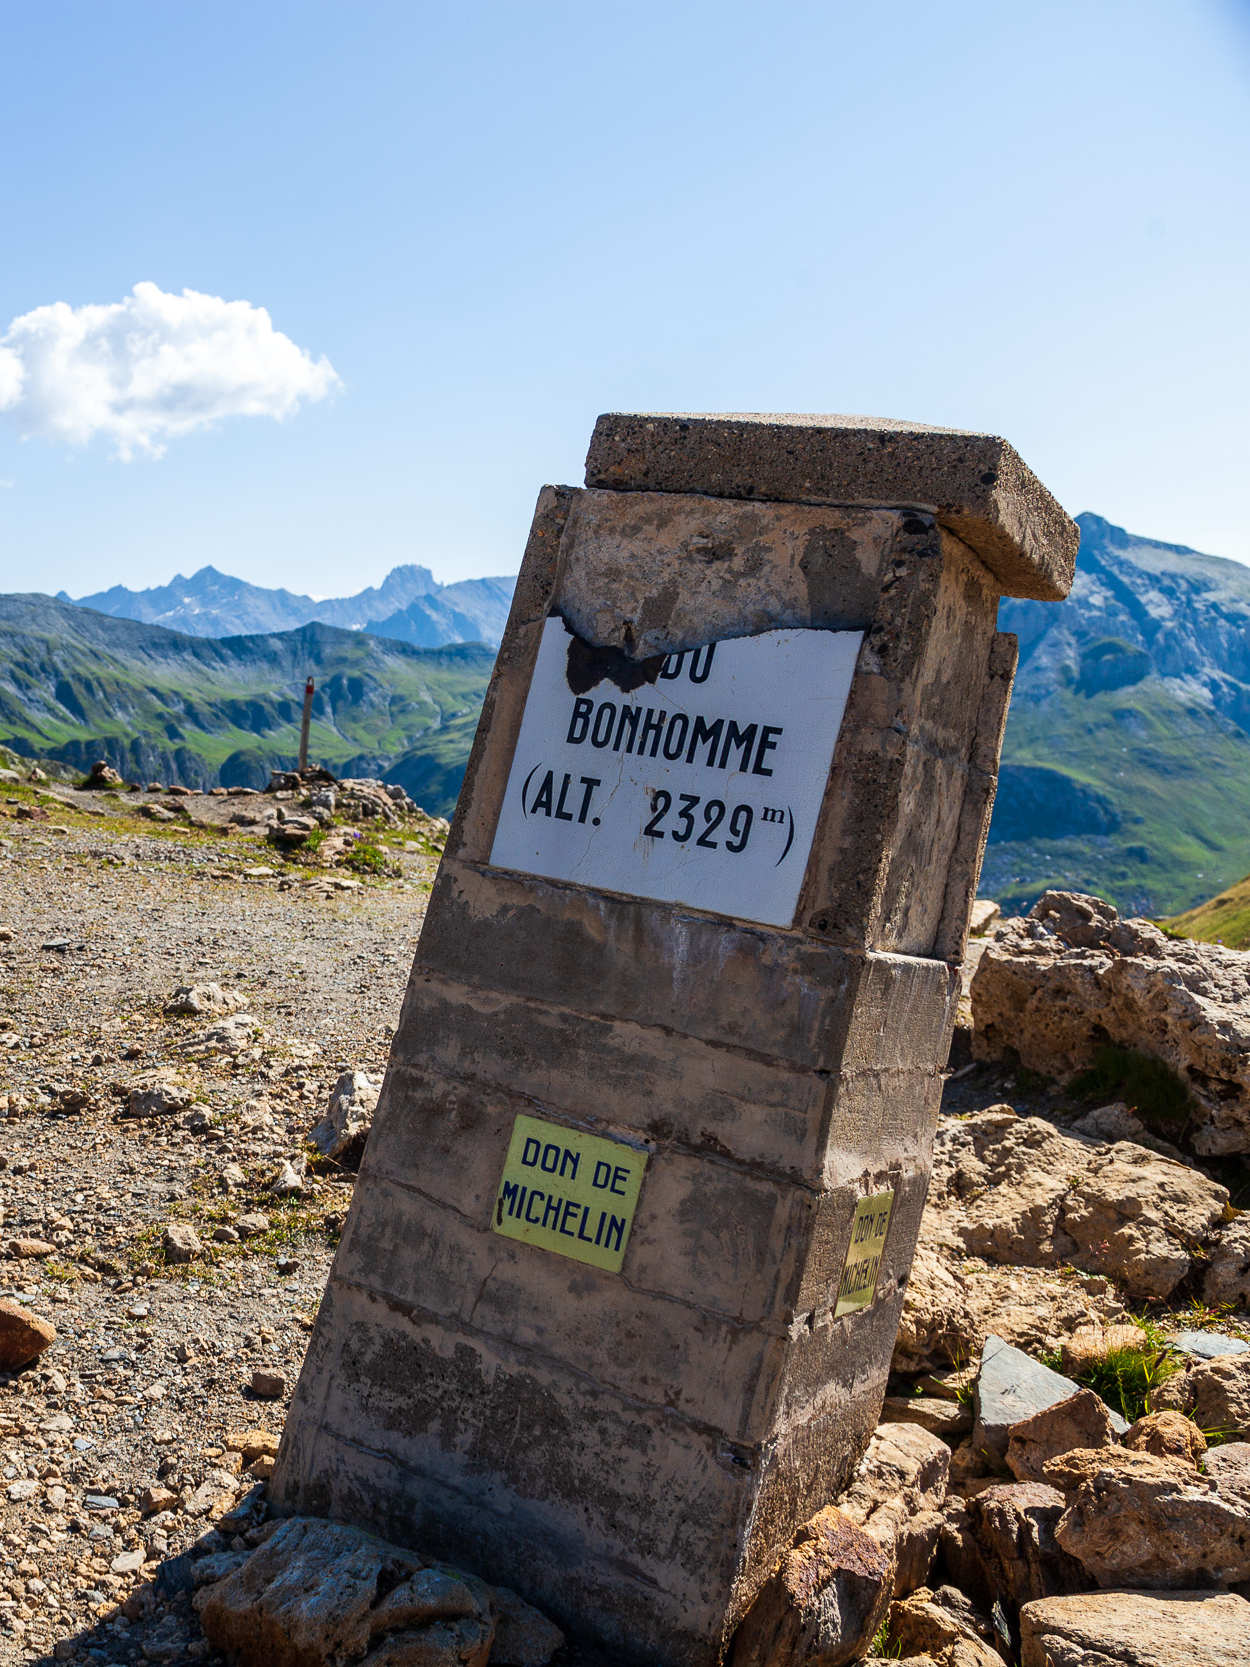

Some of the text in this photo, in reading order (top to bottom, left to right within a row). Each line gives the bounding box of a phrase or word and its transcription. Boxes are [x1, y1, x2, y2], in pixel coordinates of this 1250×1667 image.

[566, 697, 783, 777] BONHOMME
[522, 763, 601, 827] (ALT.
[521, 1137, 630, 1196] DON DE
[503, 1180, 626, 1252] MICHELIN
[854, 1211, 888, 1243] DON DE
[838, 1254, 881, 1297] MICHELIN
